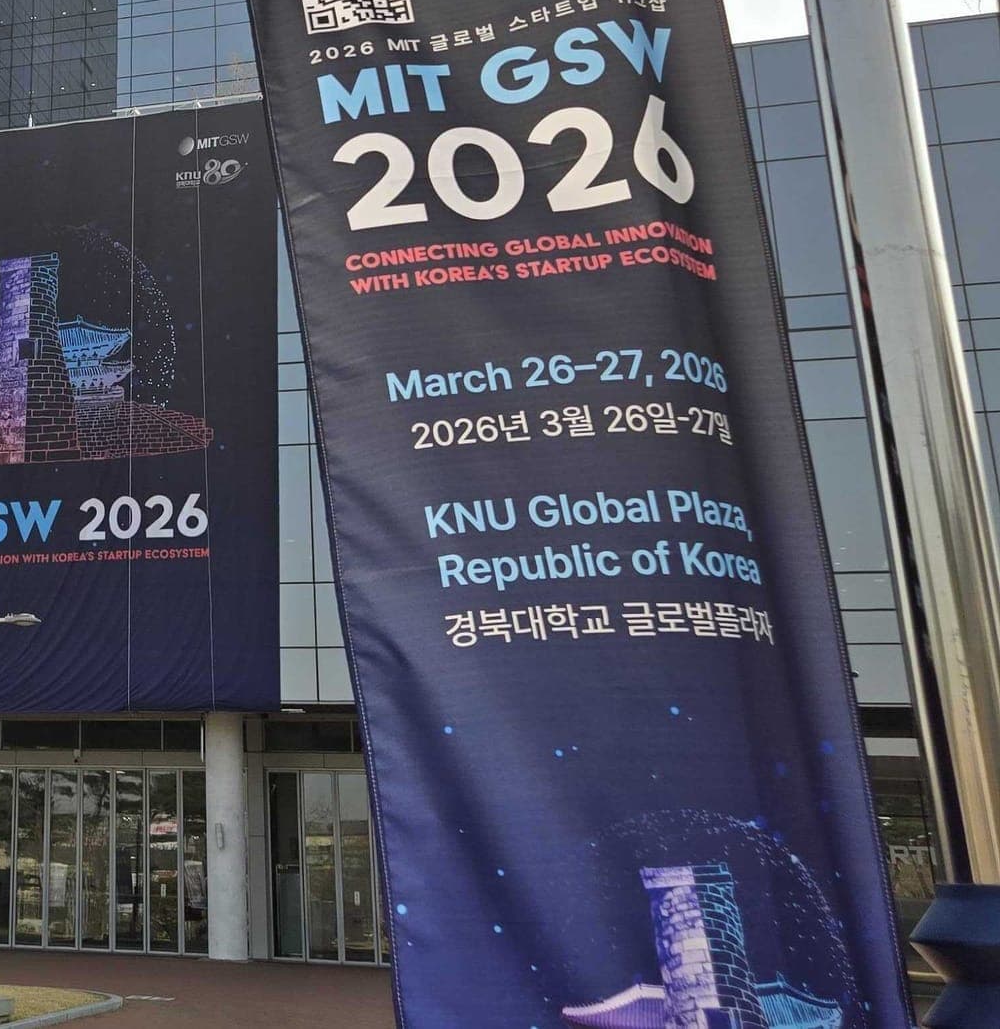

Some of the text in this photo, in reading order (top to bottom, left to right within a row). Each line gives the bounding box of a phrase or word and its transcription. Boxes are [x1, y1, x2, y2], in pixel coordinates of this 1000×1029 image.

[308, 40, 374, 65] 2026
[387, 35, 421, 53] MIT
[429, 25, 495, 53] 글로벌
[317, 18, 671, 125] MIT GSW
[332, 94, 695, 231] 2026
[345, 222, 714, 272] CONNECTING GLOBAL INNOVATION
[349, 274, 412, 296] WITH
[515, 255, 612, 280] STARTUP
[621, 248, 716, 281] ECOSYSTEM
[385, 362, 513, 403] March
[660, 349, 729, 394] 2026
[411, 401, 733, 450] 2026년 3월 26일-27일
[79, 493, 209, 541] 2026
[424, 489, 753, 542] KNU Global Plaza,
[22, 553, 50, 563] WITH
[97, 549, 142, 561] STARTUP
[145, 548, 210, 559] ECOSYSTEM
[437, 541, 762, 591] Republic of Korea
[444, 601, 775, 648] 경북대학교 글로벌플라자
